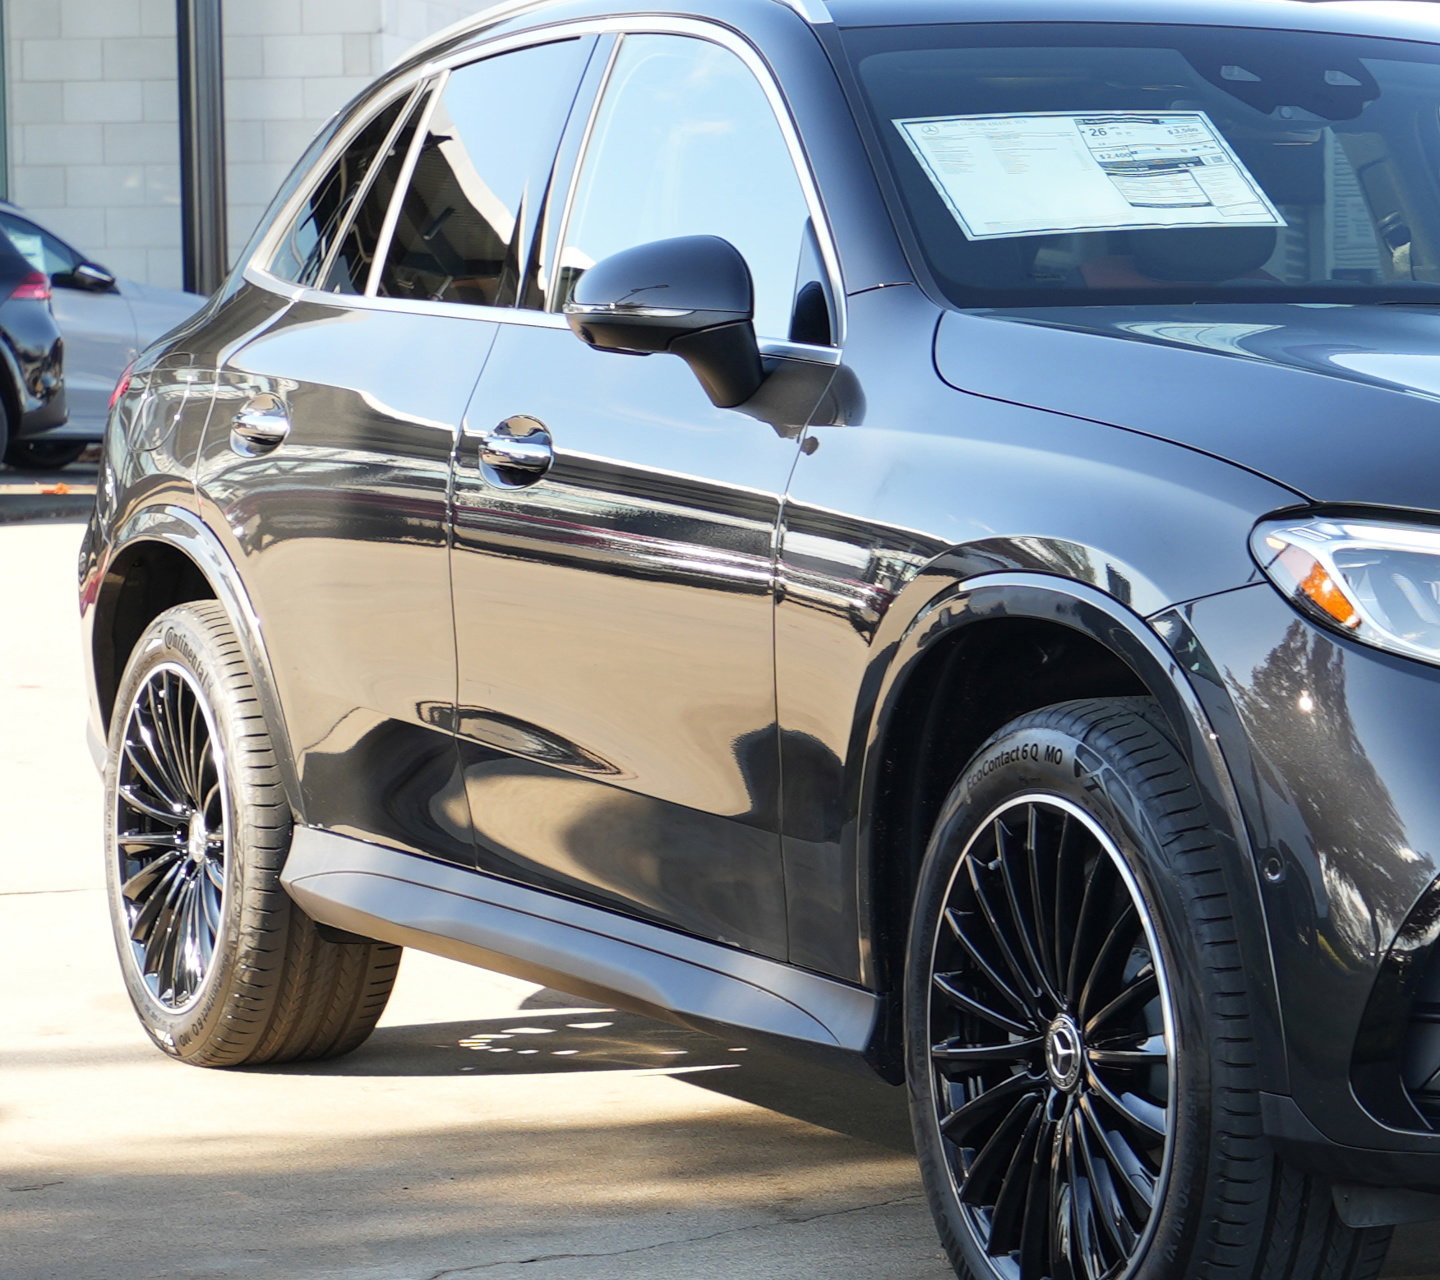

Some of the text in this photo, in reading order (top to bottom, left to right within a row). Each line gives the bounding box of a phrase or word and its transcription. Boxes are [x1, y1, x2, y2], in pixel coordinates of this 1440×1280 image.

[1088, 127, 1108, 137] 26
[165, 626, 209, 687] Continental
[1044, 745, 1063, 765] MO
